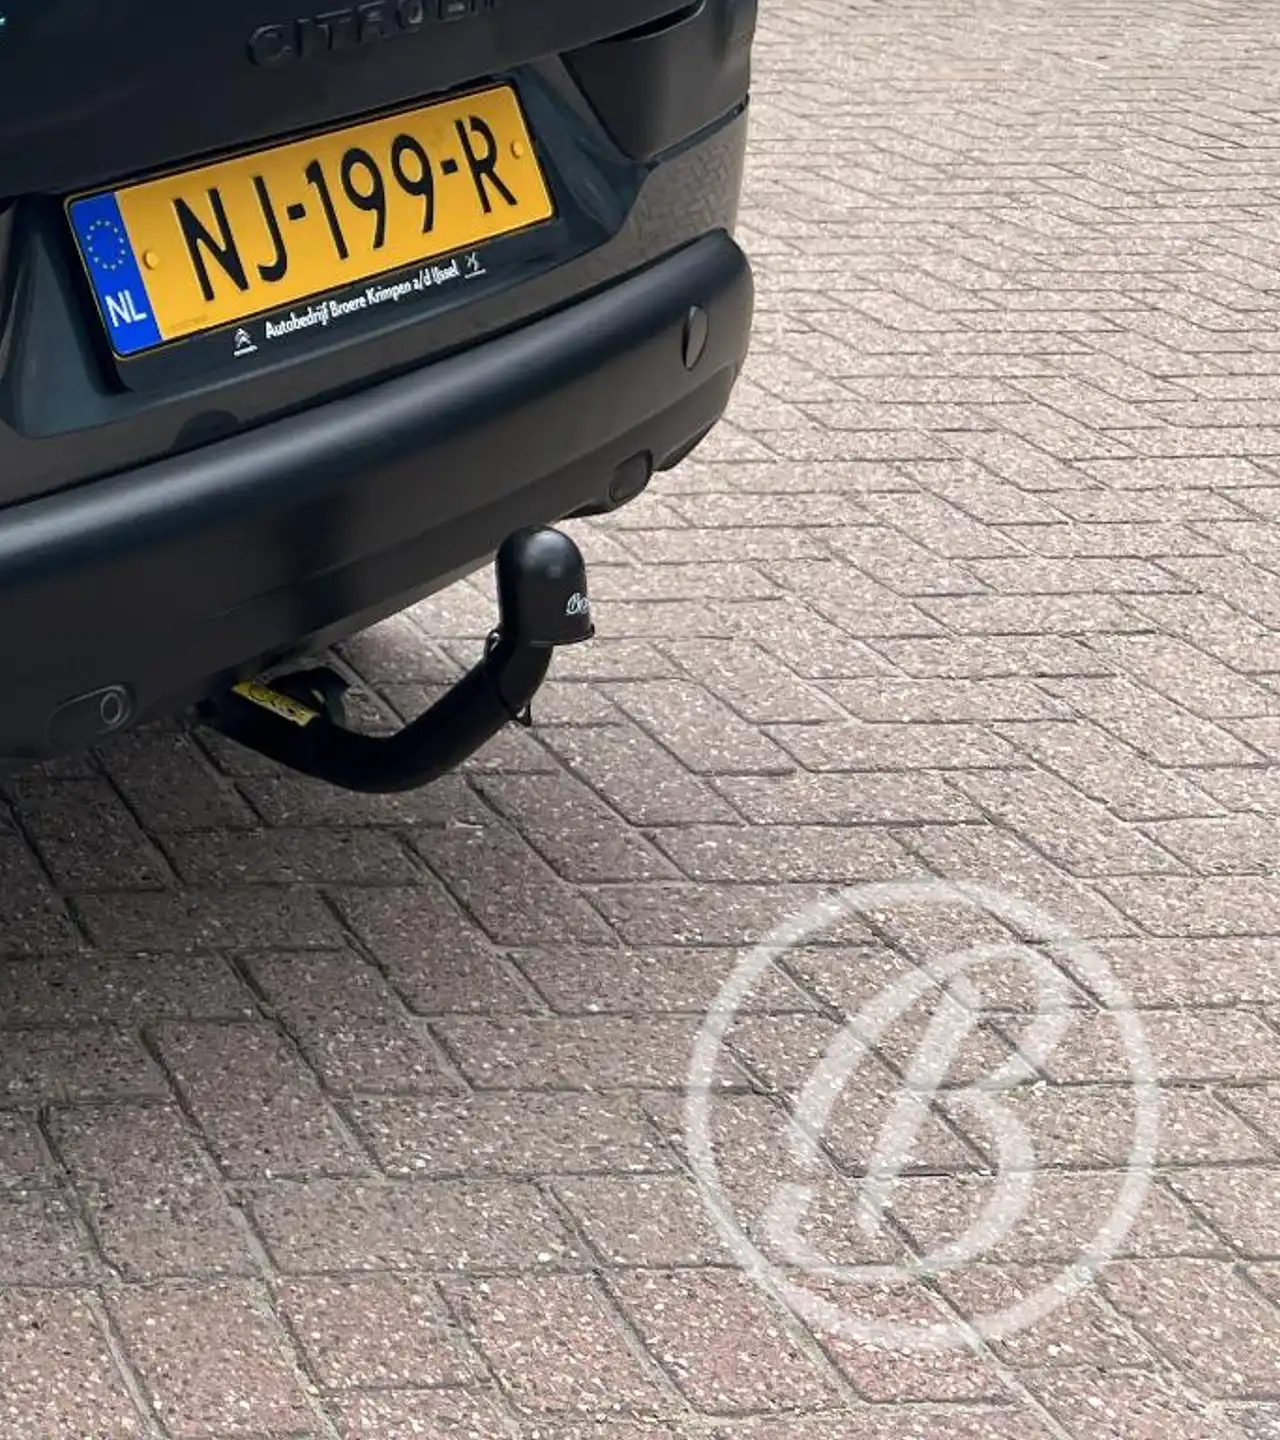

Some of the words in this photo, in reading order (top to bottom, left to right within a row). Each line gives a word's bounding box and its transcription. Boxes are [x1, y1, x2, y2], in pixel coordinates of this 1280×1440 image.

[172, 114, 518, 303] NJ-199-R
[104, 289, 147, 329] NL
[265, 301, 329, 340] Autobedrijf
[329, 294, 368, 318] Broere
[365, 278, 412, 306] Krimpen
[412, 268, 431, 291] a/d
